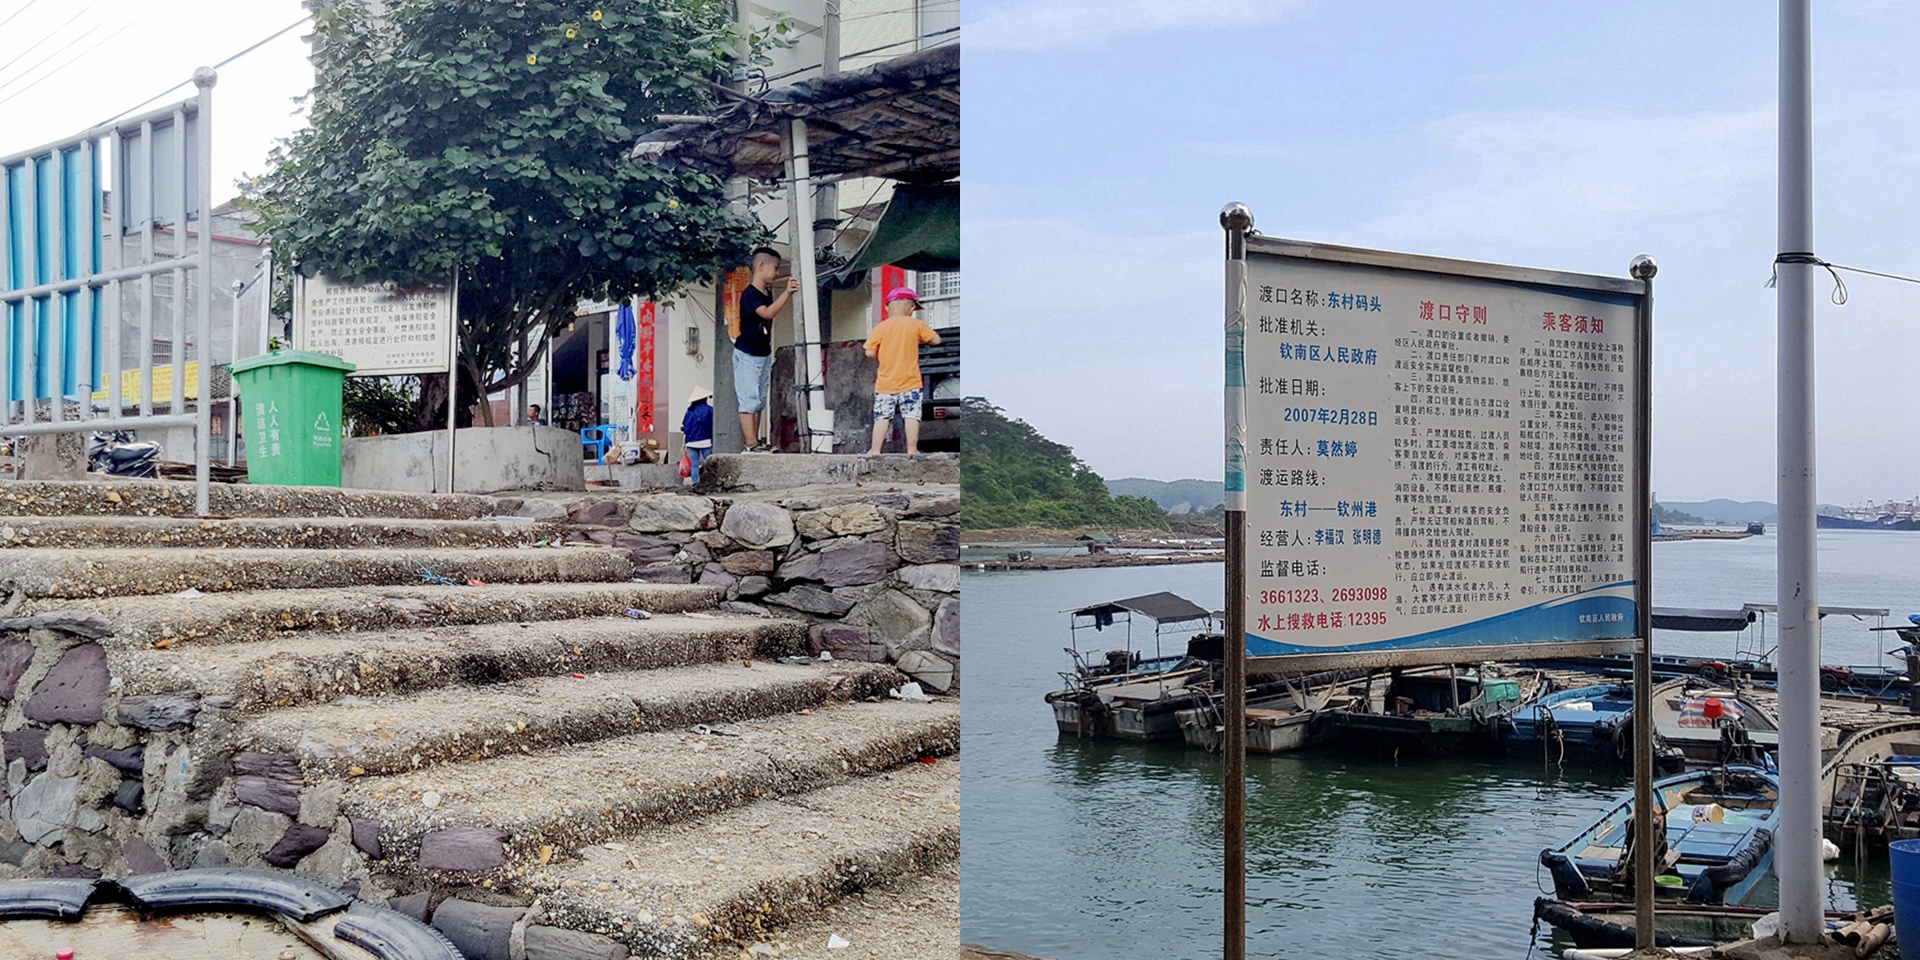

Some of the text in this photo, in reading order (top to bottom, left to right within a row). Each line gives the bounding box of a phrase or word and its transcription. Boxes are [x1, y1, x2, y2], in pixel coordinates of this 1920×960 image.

[1420, 300, 1487, 325] 渡口守则
[1259, 315, 1325, 337] 批准机关：
[1542, 312, 1604, 334] 乘客须知
[1279, 342, 1378, 366] 钦南区人民政府
[1259, 376, 1326, 396] 批准日期：
[1284, 407, 1378, 427] 2007年2月28日
[1395, 416, 1421, 425] 运安全。
[256, 403, 268, 458] 清洁卫生
[269, 401, 281, 456] 人人有责
[1259, 468, 1326, 487] 渡运路线：
[1352, 529, 1382, 546] 张明德
[1260, 559, 1327, 578] 监督电话：
[1260, 587, 1388, 604] 3661323、2693098
[1579, 613, 1624, 623] 钦南区人民政府
